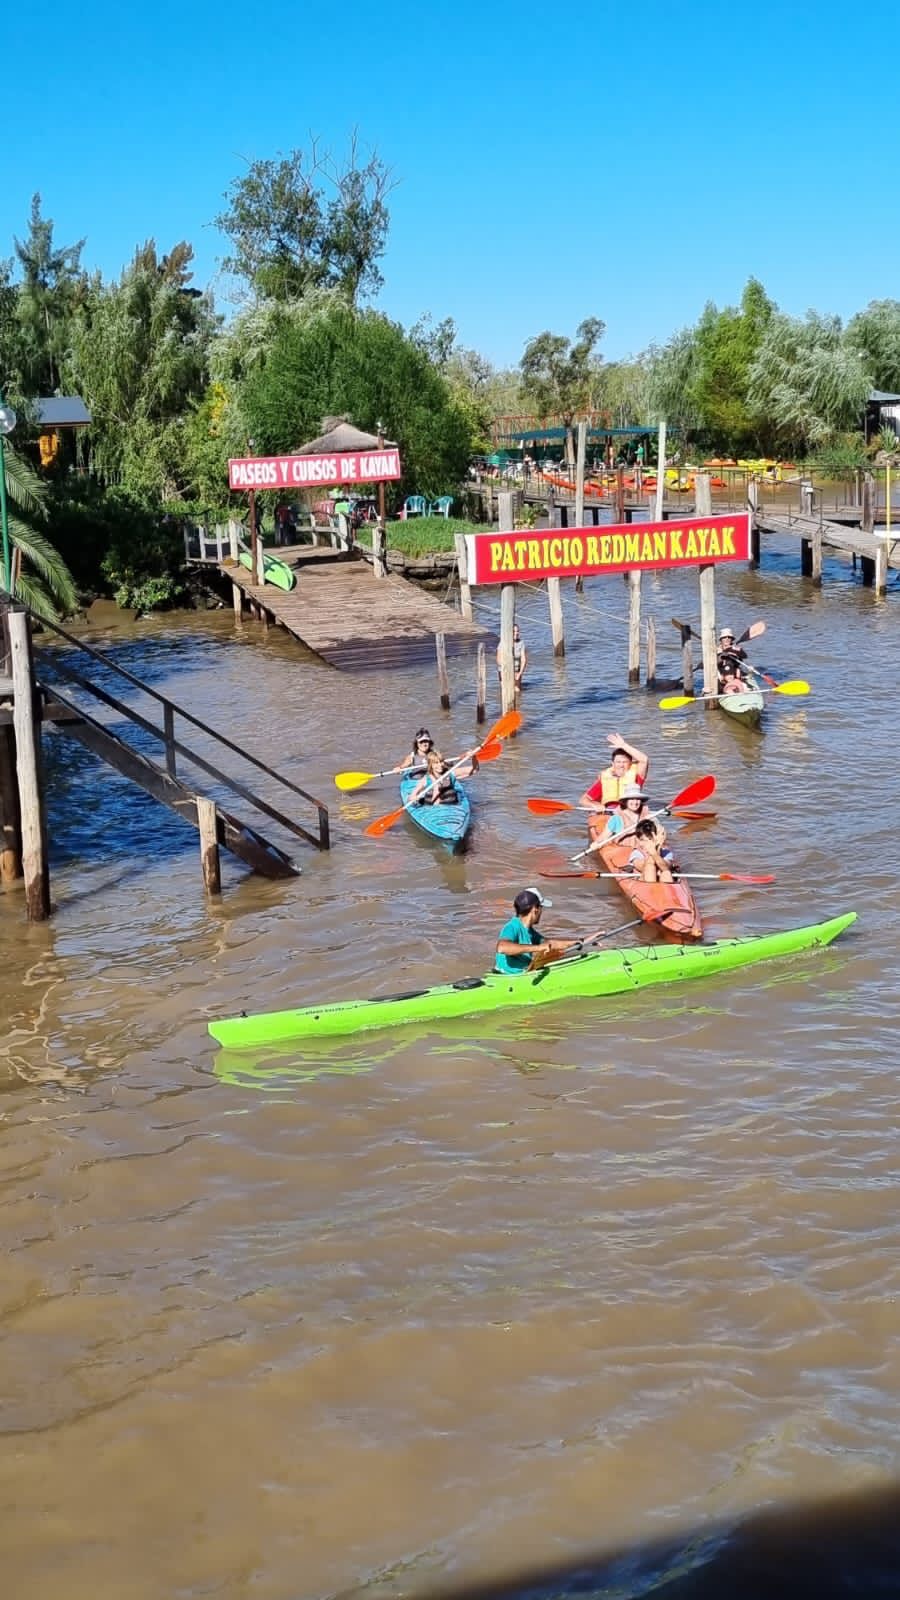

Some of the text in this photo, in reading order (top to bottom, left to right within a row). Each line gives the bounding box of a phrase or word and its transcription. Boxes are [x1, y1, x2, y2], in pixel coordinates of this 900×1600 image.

[231, 455, 397, 485] PASEOS Y CURSOS DE KAYAK
[490, 526, 736, 571] PATRICIO REDMAN KAYAK
